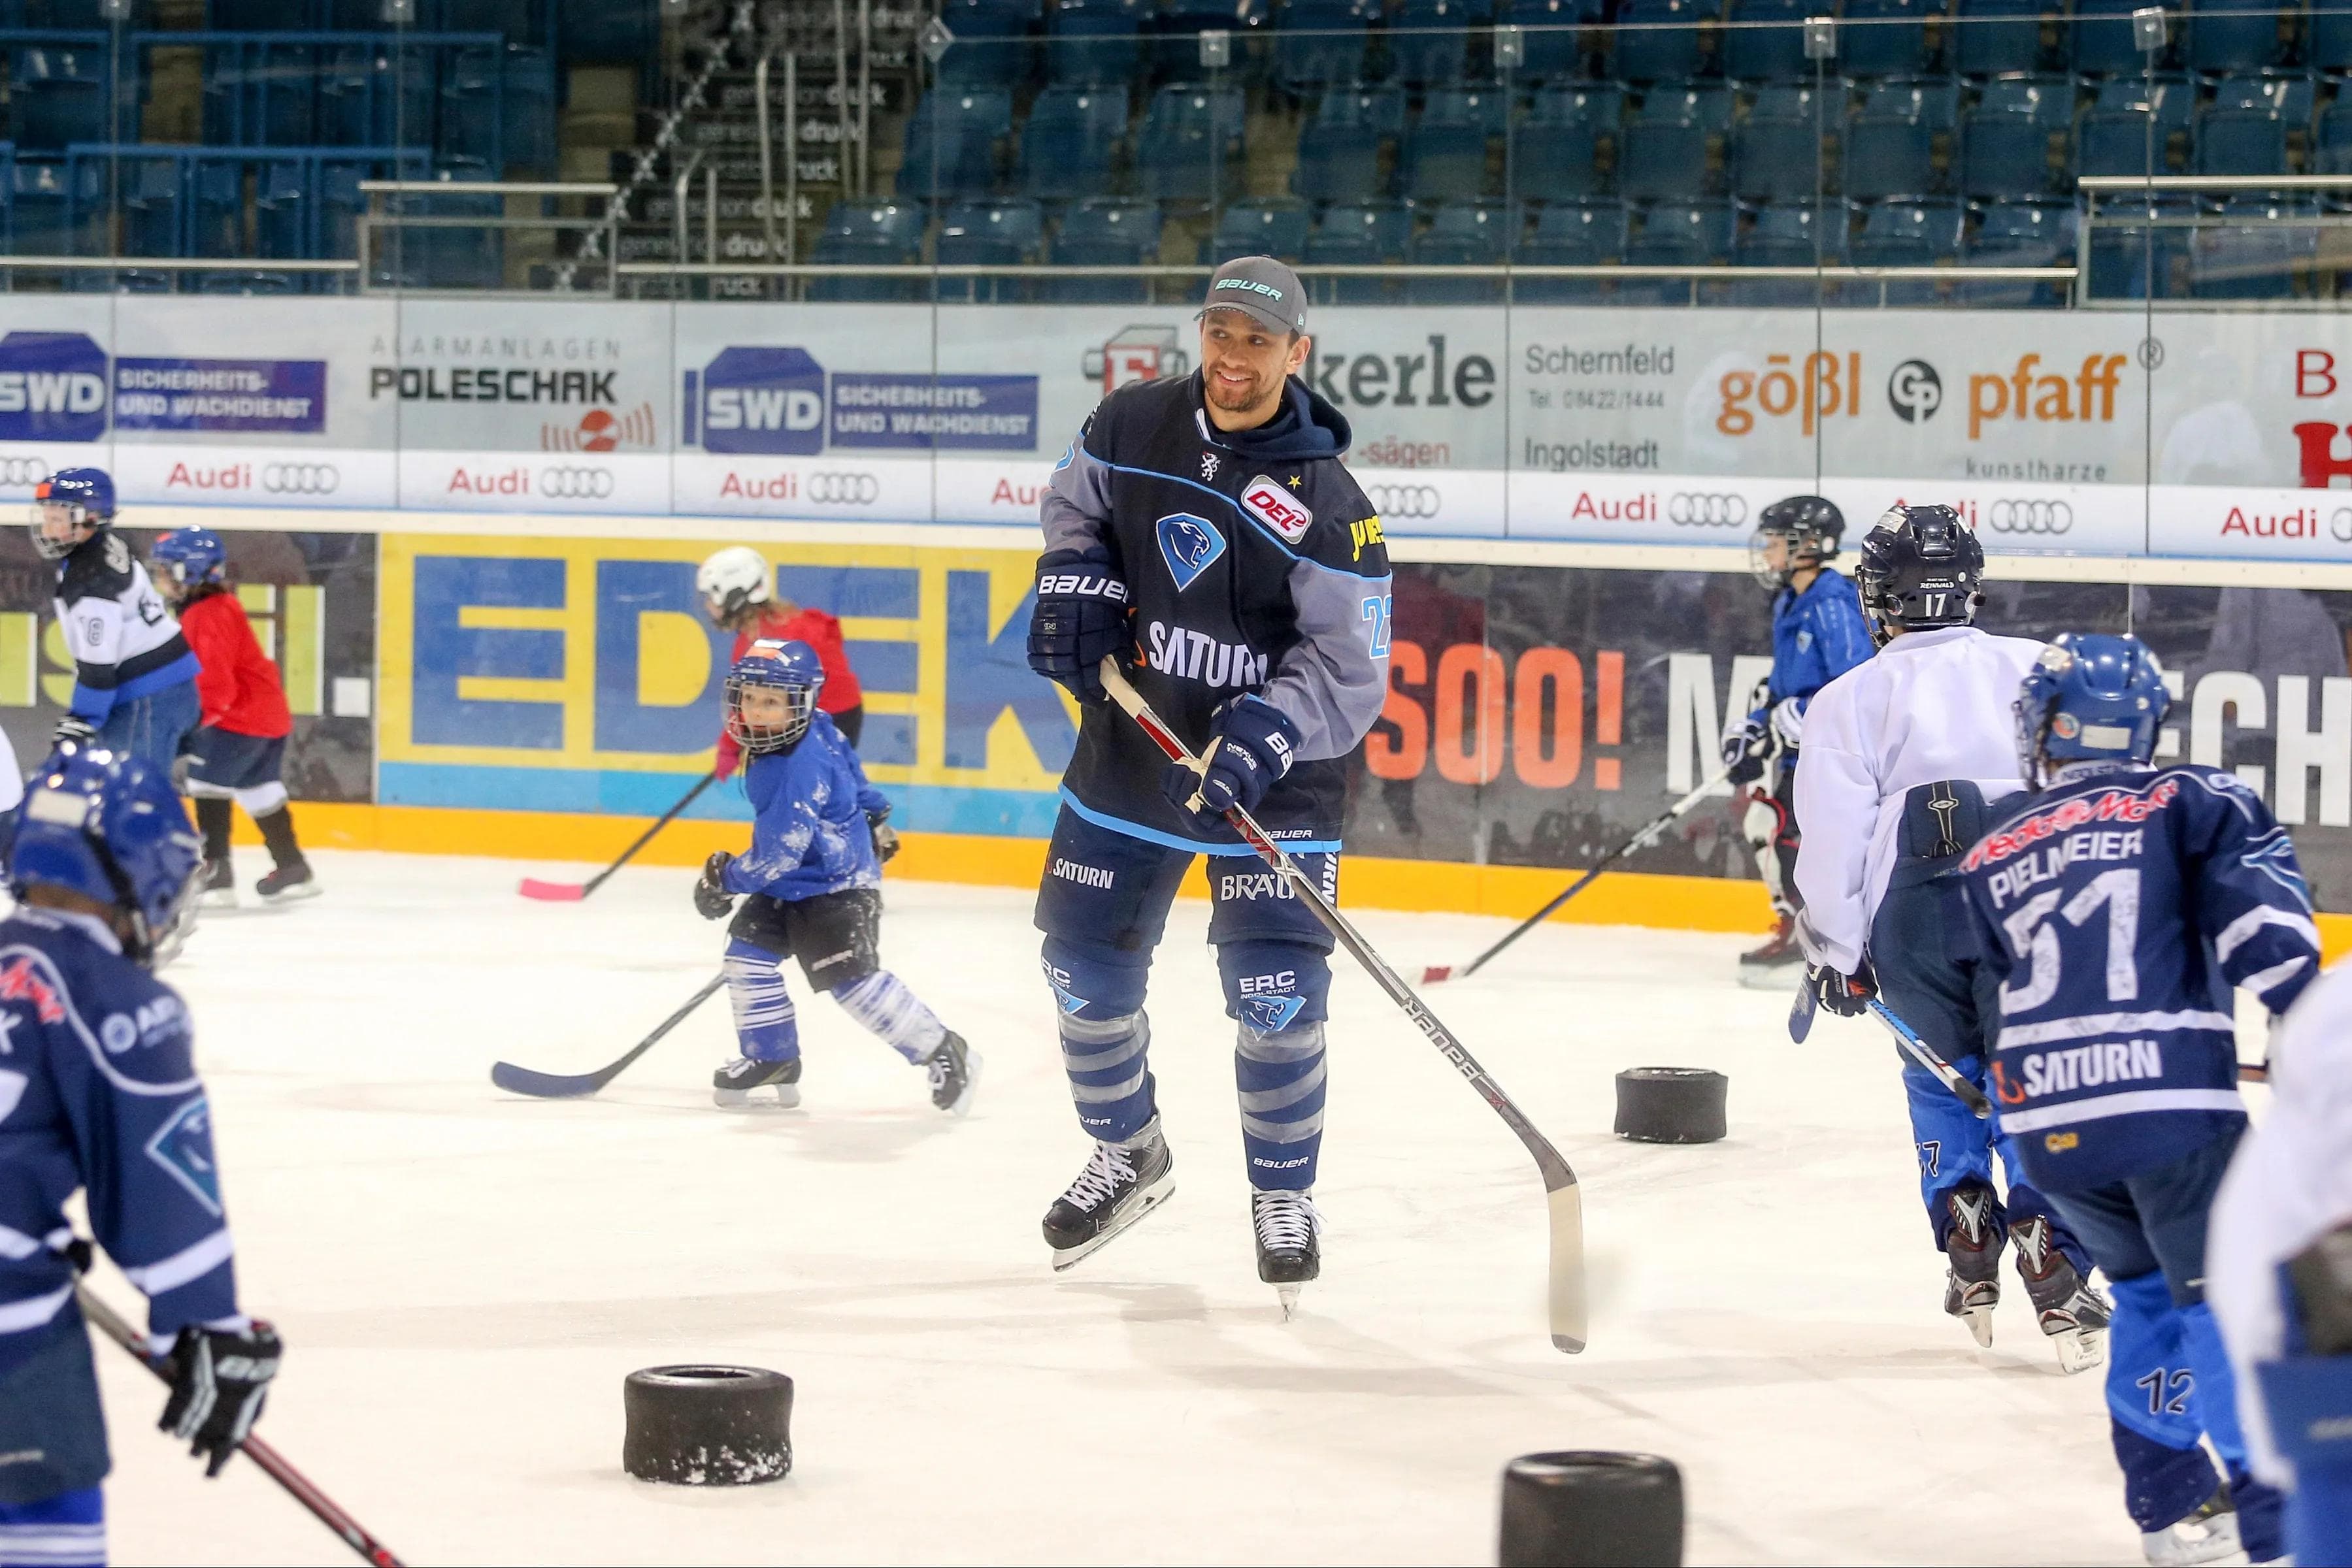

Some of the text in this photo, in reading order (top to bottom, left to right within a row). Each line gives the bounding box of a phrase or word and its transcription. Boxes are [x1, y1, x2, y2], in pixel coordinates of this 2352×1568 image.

[371, 336, 621, 361] AARMANLAGEN
[1525, 344, 1675, 375] Schernfeld
[371, 367, 618, 404] POLESCHAK
[1304, 334, 1495, 407] kerle
[0, 371, 105, 414] SWD
[118, 394, 168, 416] UND
[1967, 353, 2128, 441] pfaff
[707, 389, 823, 431] SWD
[836, 412, 1031, 435] UND WACHDIENST
[1525, 437, 1659, 472] Ingolstadt
[1966, 458, 2106, 482] kunstharze
[167, 462, 252, 490] Audi
[449, 468, 529, 495] Audi
[720, 472, 797, 500] Audi
[991, 478, 1050, 506] Au
[1572, 491, 1658, 522] Audi
[2221, 505, 2318, 538] Audi
[1925, 593, 1947, 617] 17
[412, 555, 1080, 775] EDEK
[1363, 640, 1625, 791] SOO!
[1052, 857, 1114, 889] SATURN
[1987, 828, 2144, 910] PIELMEIER
[2000, 868, 2141, 1017] 51
[1041, 955, 1071, 985] RC
[1238, 970, 1295, 993] ERC
[2023, 1039, 2161, 1098] SATURN
[1079, 1114, 1112, 1126] UER
[2136, 1367, 2196, 1414] 12
